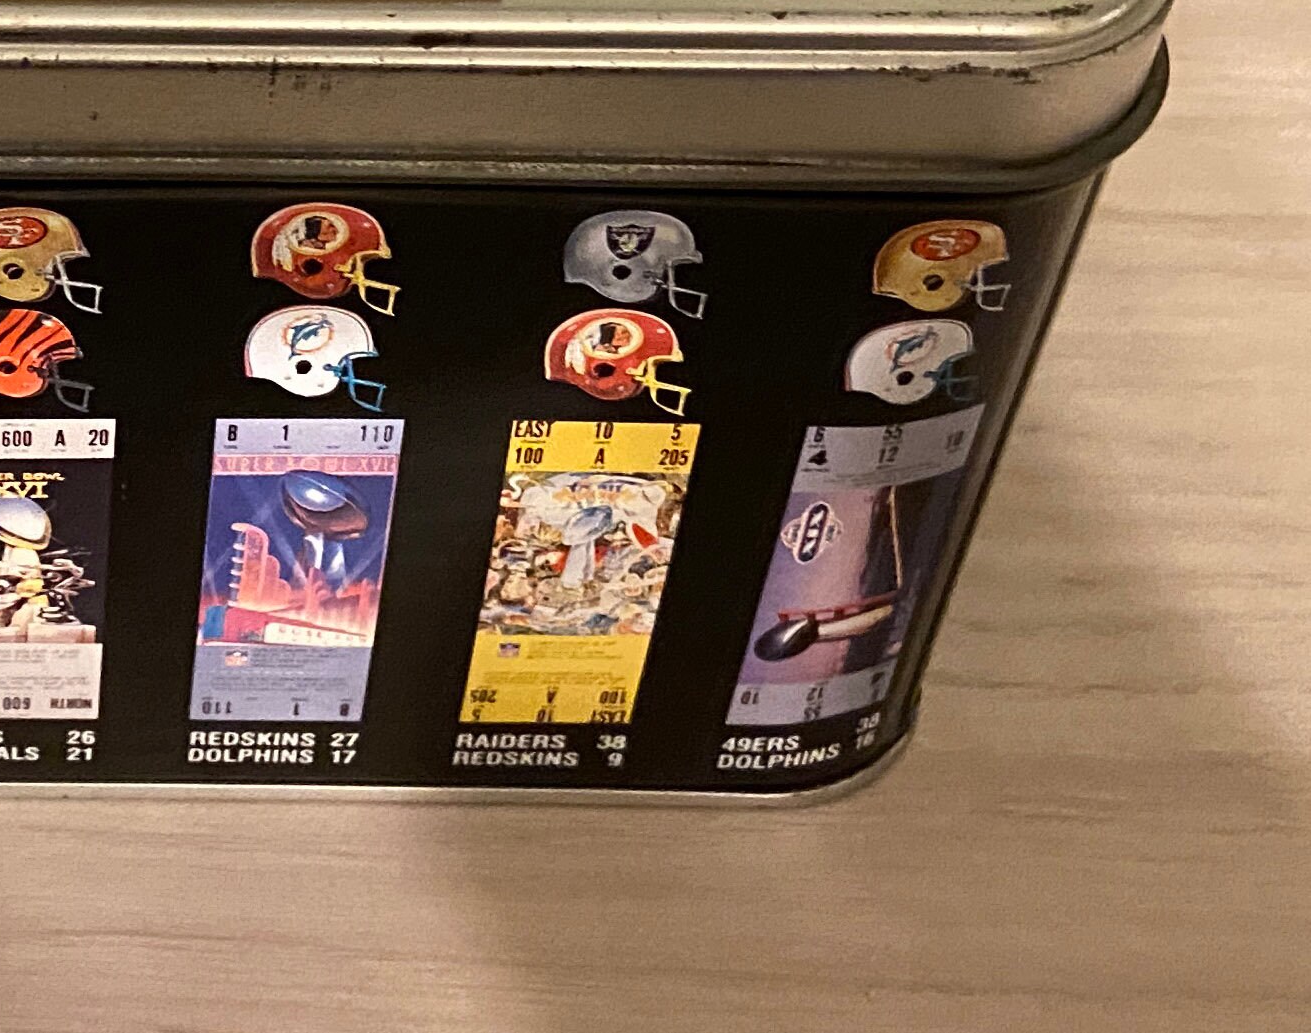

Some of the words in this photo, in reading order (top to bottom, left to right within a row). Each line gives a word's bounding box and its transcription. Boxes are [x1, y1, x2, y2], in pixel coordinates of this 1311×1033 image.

[1, 430, 33, 447] 600
[54, 429, 66, 446] A
[88, 429, 110, 446] 20
[282, 424, 289, 442] 1
[360, 425, 395, 443] 110
[594, 422, 614, 439] 10
[670, 424, 682, 440] 5
[515, 447, 544, 464] 100
[594, 448, 605, 465] A
[658, 448, 690, 466] 205
[66, 730, 96, 745] 26
[189, 731, 316, 747] REDSKINS
[329, 732, 360, 747] 27
[455, 733, 567, 749] RAIDERS
[596, 734, 627, 749] 38
[721, 735, 801, 752] 49ERS
[66, 747, 94, 761] 21
[188, 747, 315, 764] DOLPHINS
[331, 749, 357, 764] 17
[451, 750, 581, 767] REDSKINS
[607, 752, 624, 767] 9
[716, 743, 841, 769] DOLPHINS
